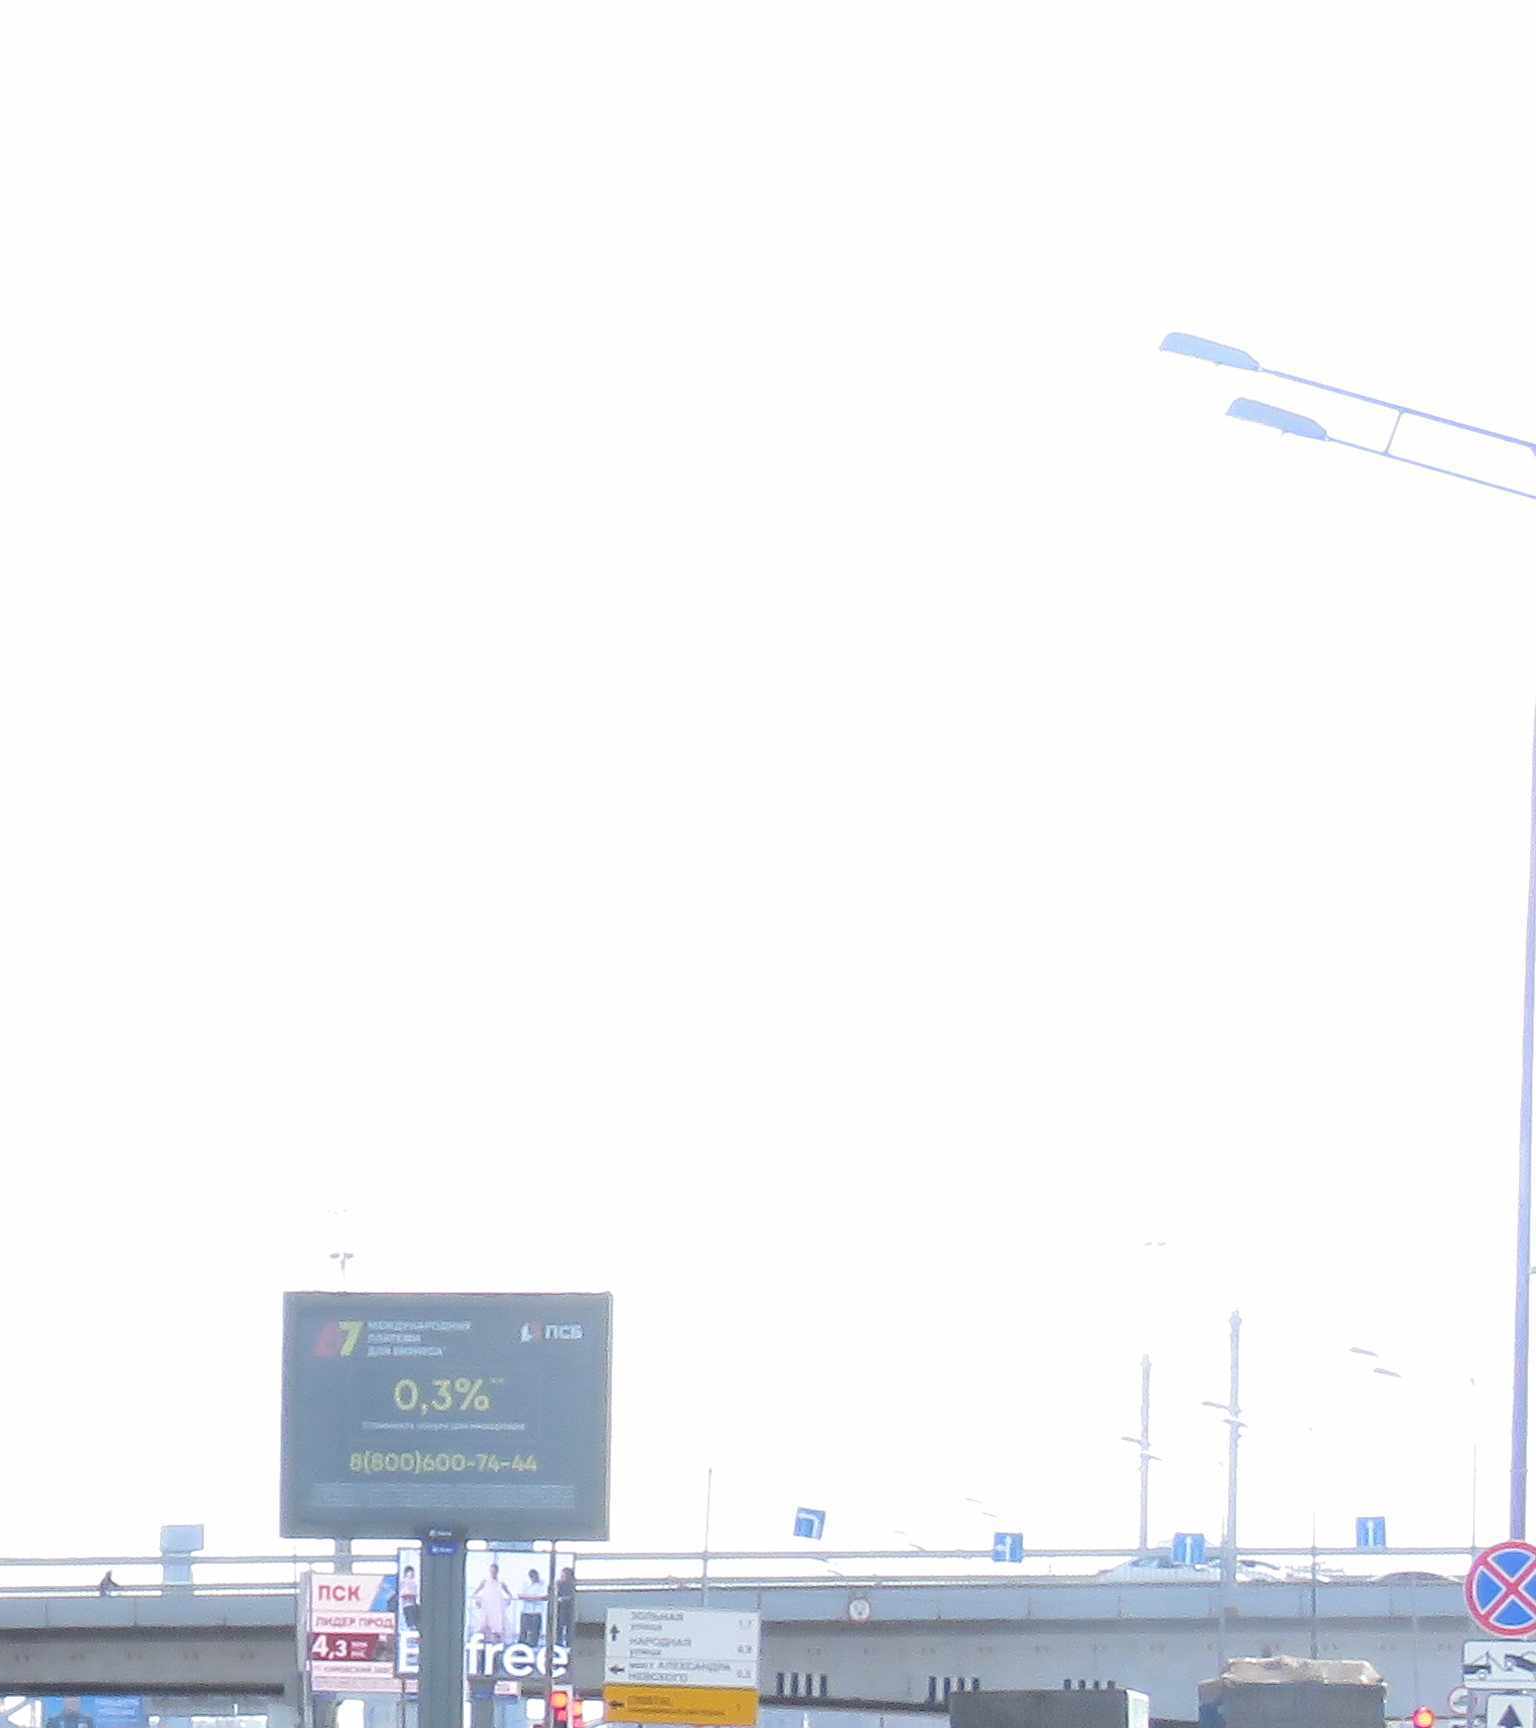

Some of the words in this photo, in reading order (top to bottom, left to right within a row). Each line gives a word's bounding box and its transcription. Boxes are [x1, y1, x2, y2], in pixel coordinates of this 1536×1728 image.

[545, 1325, 584, 1340] ПСБ
[318, 1585, 361, 1601] ПСК
[312, 1635, 348, 1660] 4,3
